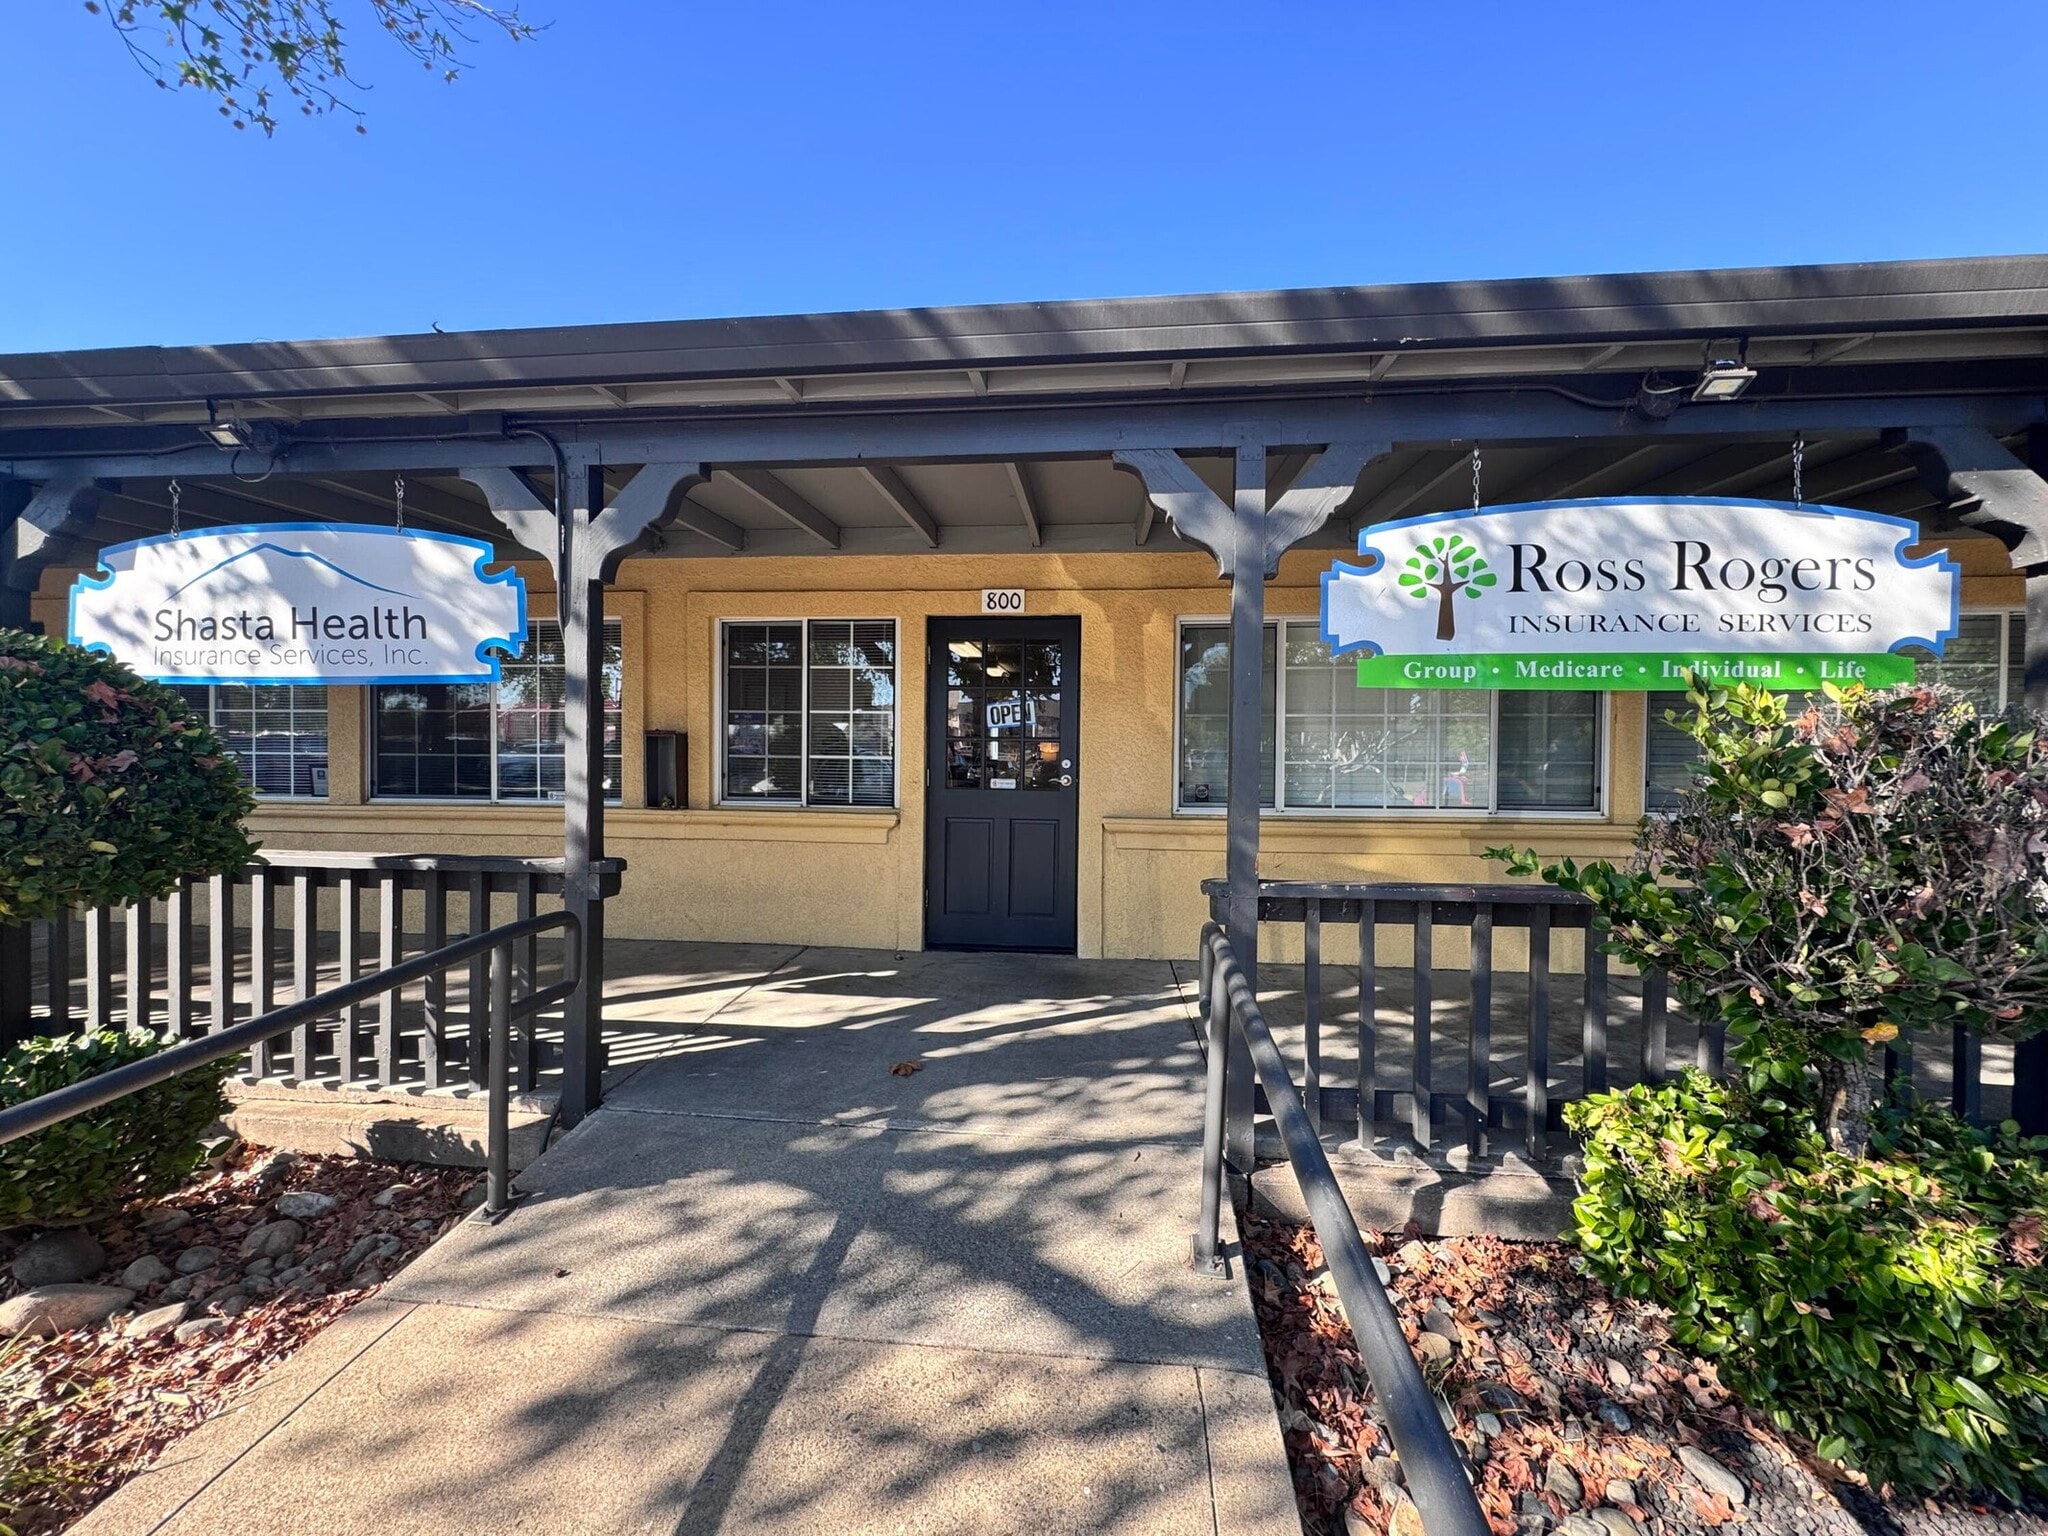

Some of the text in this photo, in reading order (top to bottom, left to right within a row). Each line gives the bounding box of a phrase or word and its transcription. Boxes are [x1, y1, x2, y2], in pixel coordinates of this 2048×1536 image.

[1506, 540, 1876, 604] Ross Rogers
[986, 592, 1021, 610] 800
[153, 606, 427, 642] Shasta Health
[1509, 613, 1872, 634] INSURANCE SERVICES
[154, 643, 428, 667] Insurance Services, Inc.
[1403, 660, 1866, 682] Group Medicare Individual Life
